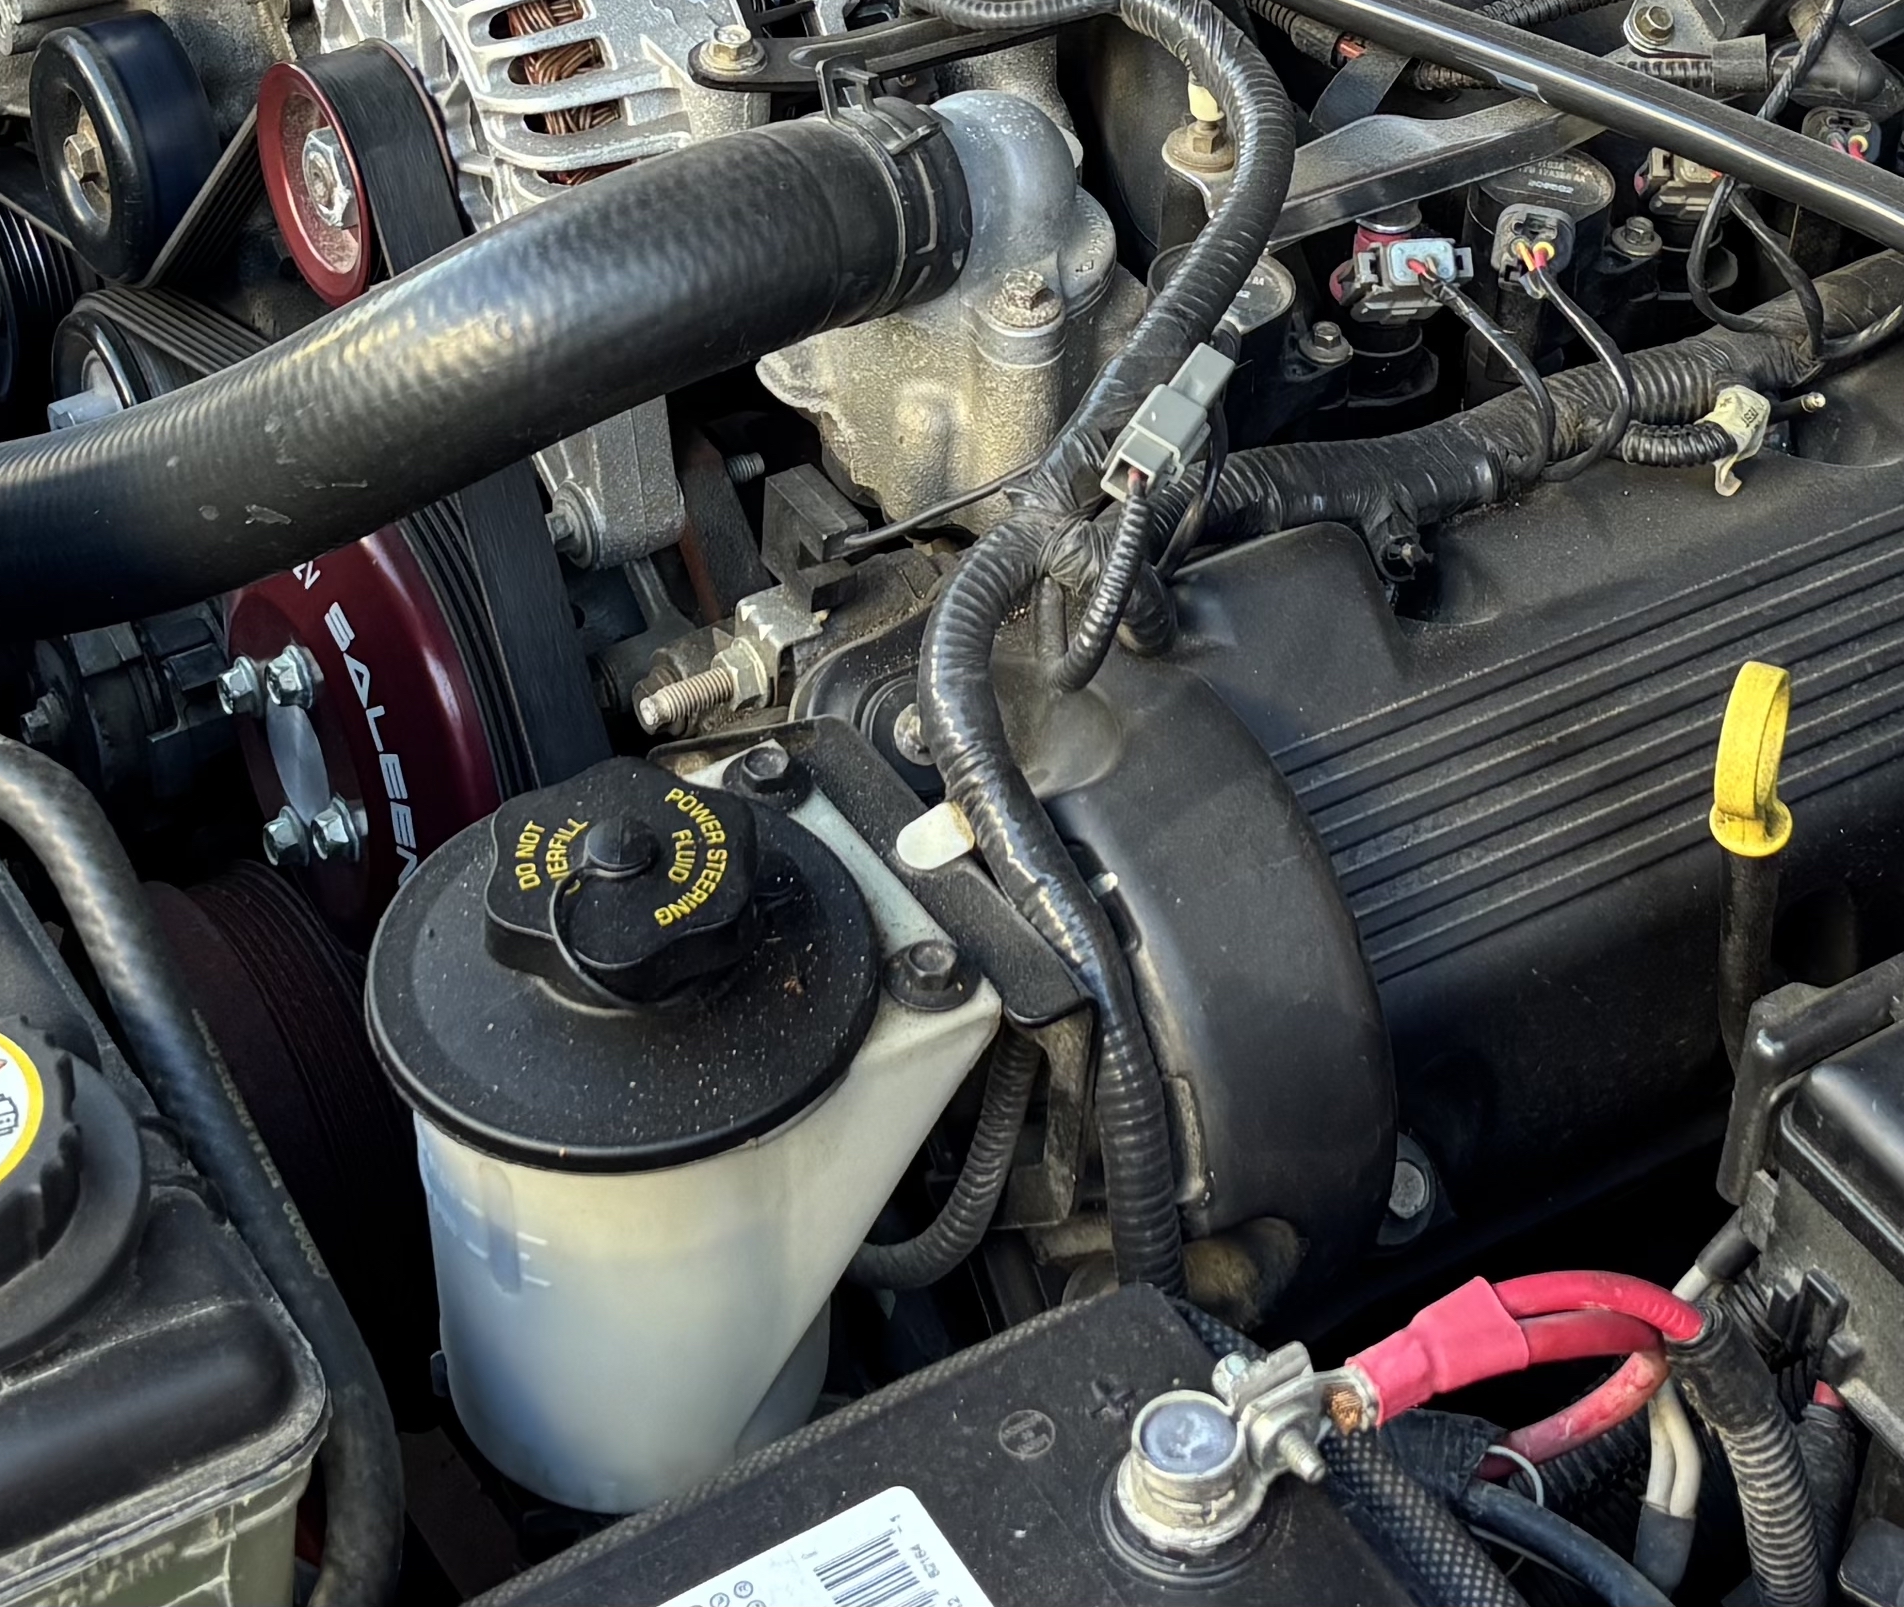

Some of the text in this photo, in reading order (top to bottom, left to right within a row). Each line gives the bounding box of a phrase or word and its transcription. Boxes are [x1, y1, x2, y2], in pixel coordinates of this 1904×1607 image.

[515, 820, 546, 891] DO NOT
[653, 787, 728, 927] POWER STEERING
[667, 828, 696, 883] FLUID
